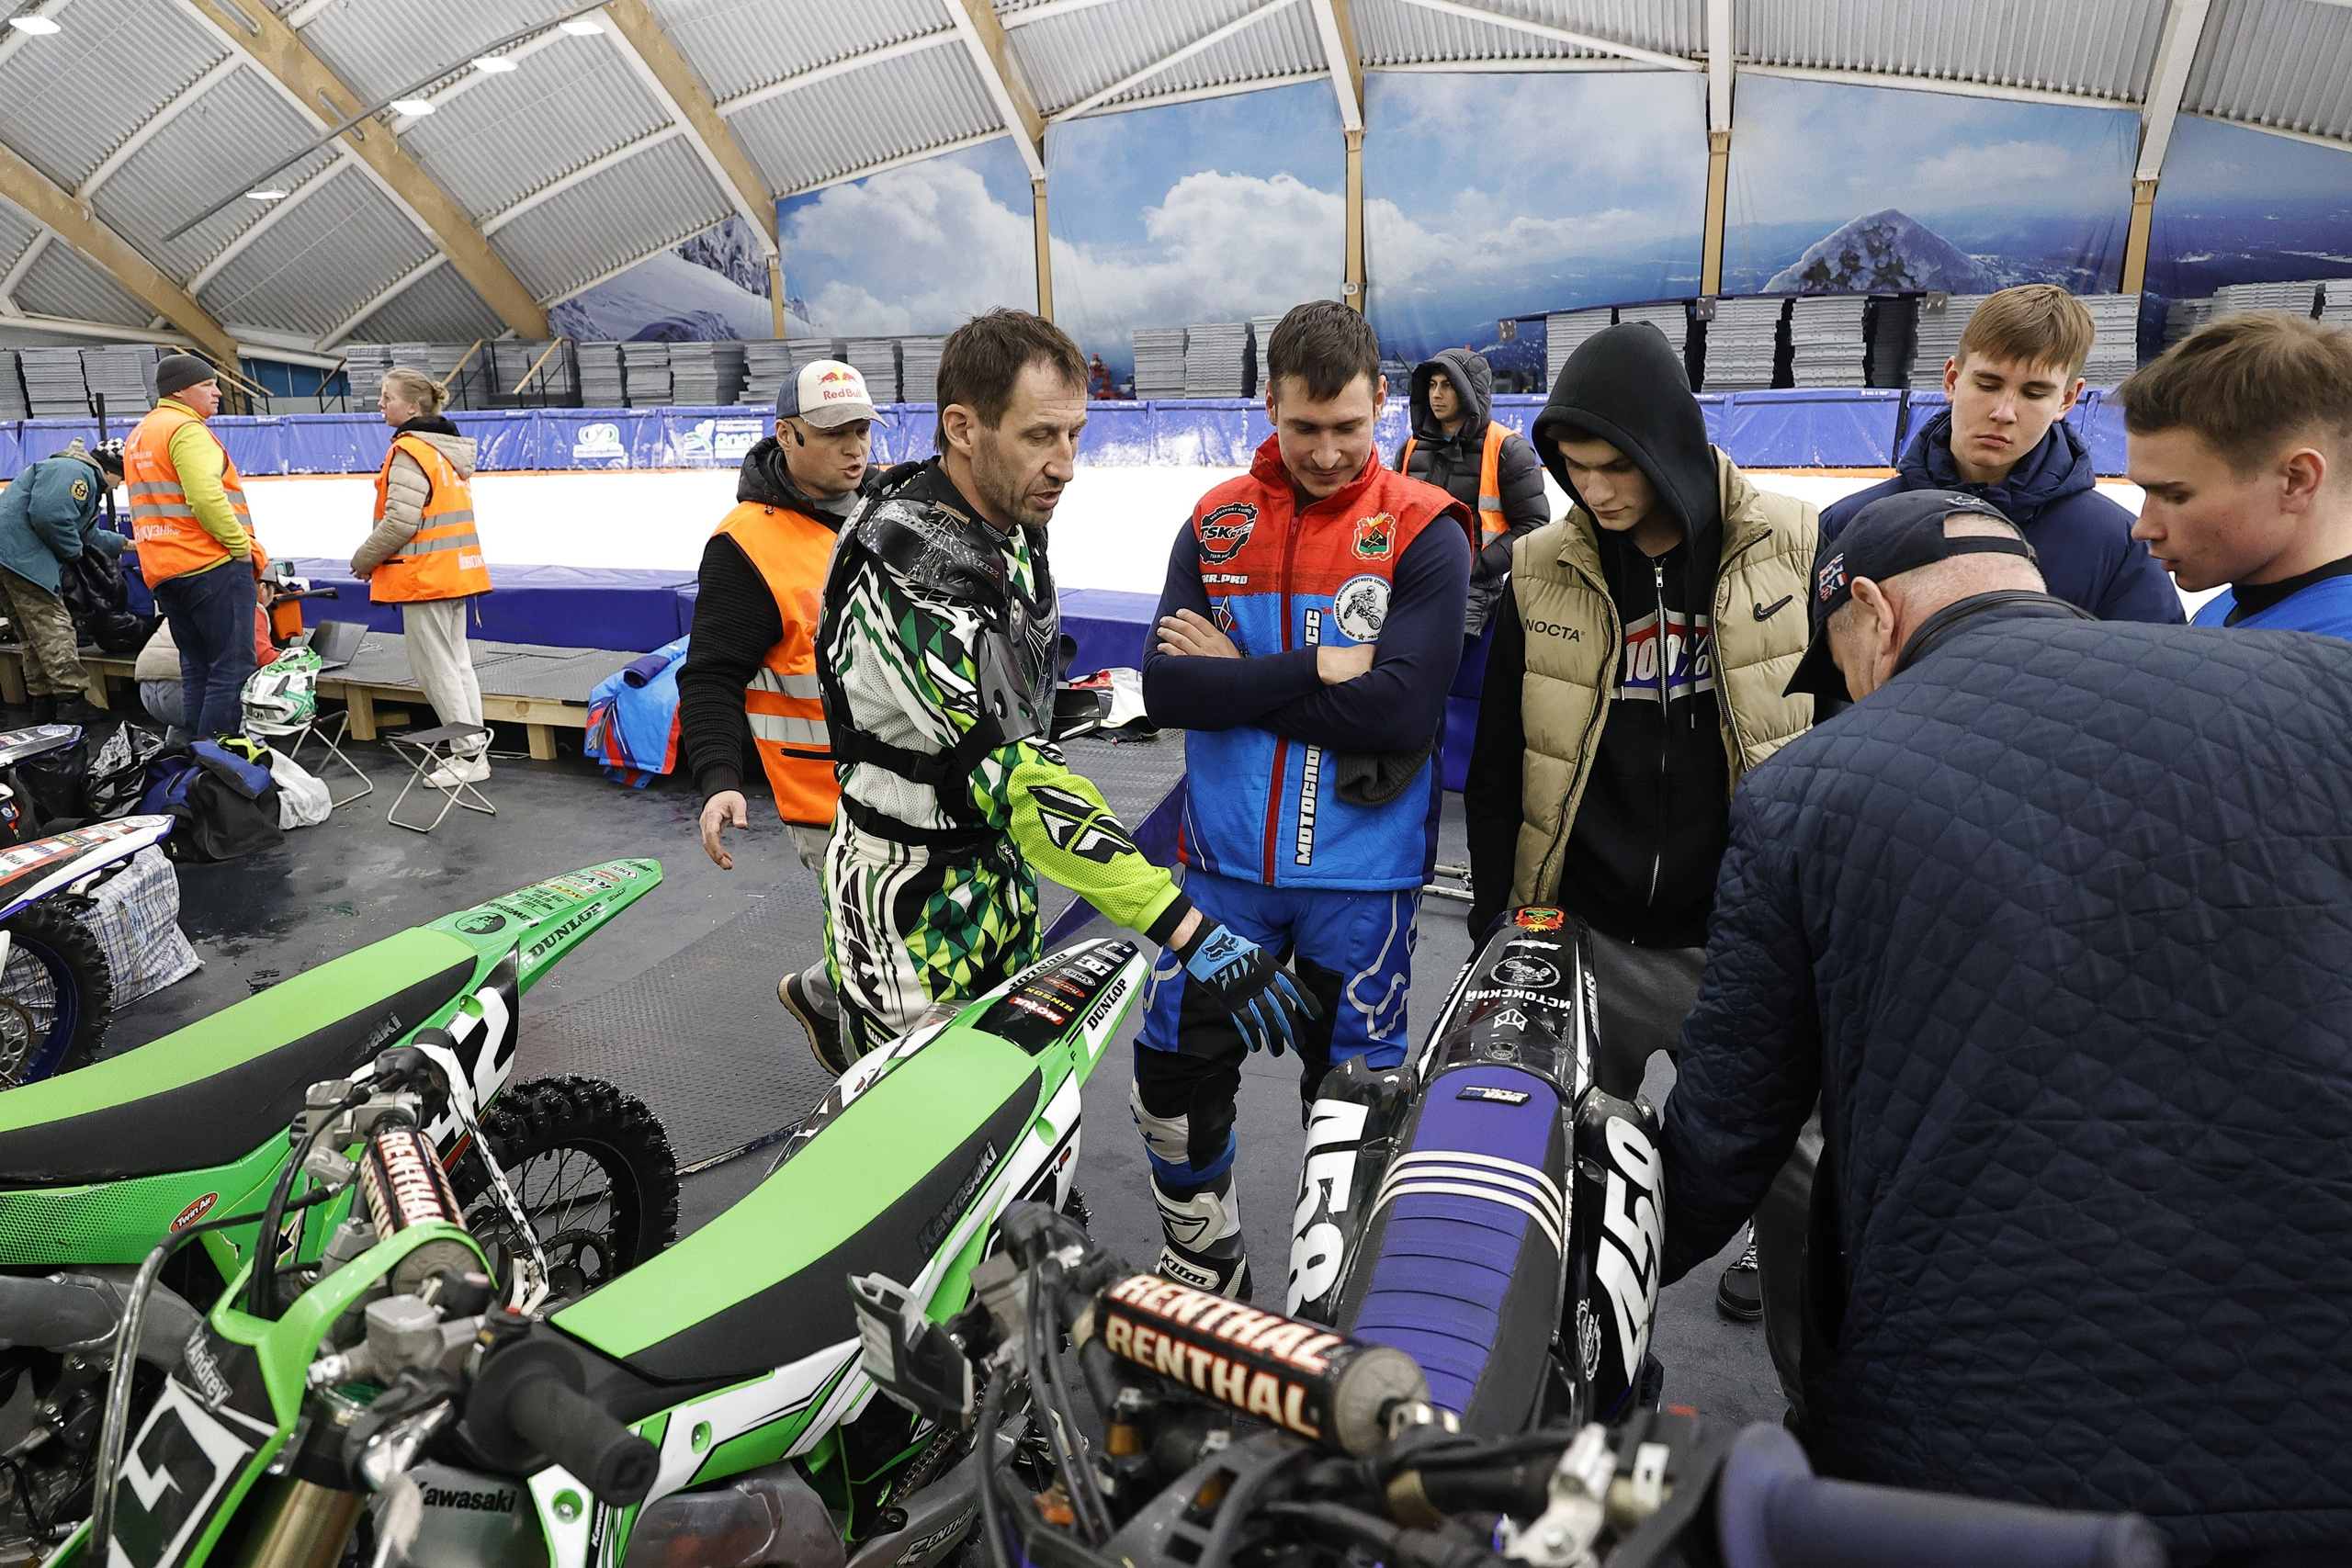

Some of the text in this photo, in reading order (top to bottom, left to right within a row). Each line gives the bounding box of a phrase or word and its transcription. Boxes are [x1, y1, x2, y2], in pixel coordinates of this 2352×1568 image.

[823, 388, 863, 400] Red Bull
[1525, 619, 1580, 642] NOCTA
[1625, 633, 1710, 682] 100%
[528, 902, 601, 958] DUNLOP
[1008, 952, 1069, 992] DUNLOP
[1023, 987, 1075, 1013] HINSON
[1086, 977, 1128, 1032] DUNLOP
[1464, 988, 1572, 1010] ИСТОКСКИЙ
[176, 1195, 212, 1227] Twin Air
[920, 1140, 997, 1258] Kawasaki
[1109, 1273, 1331, 1374] RENTHAL
[187, 1343, 229, 1407] Andrey
[1104, 1314, 1321, 1438] RENTHAL
[418, 1482, 517, 1513] awasaki
